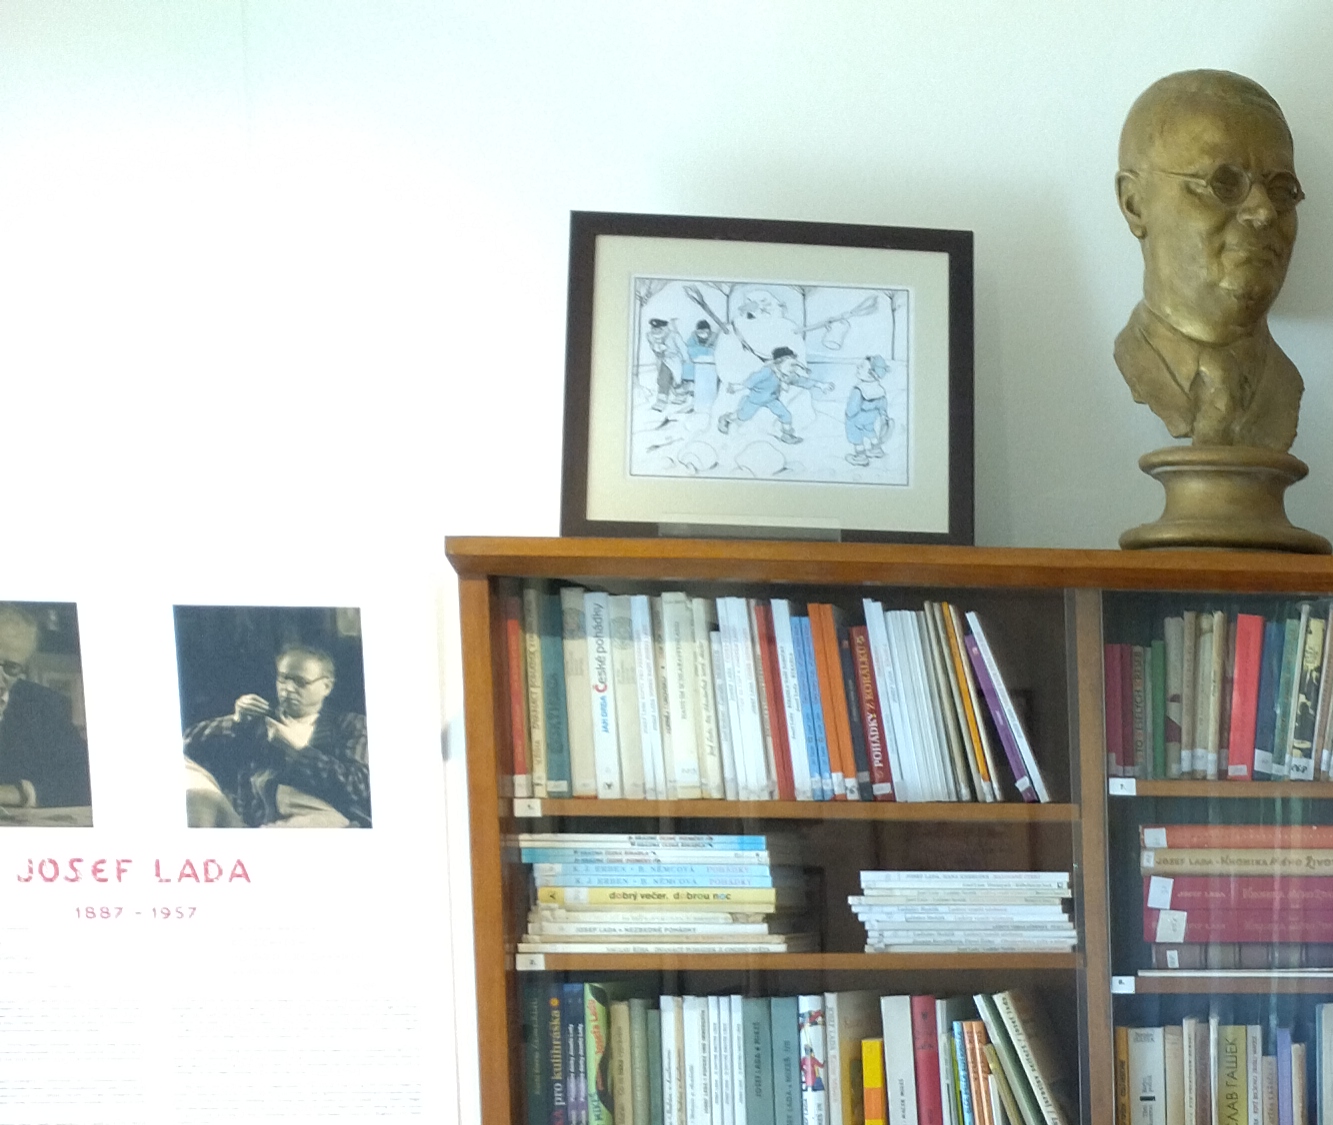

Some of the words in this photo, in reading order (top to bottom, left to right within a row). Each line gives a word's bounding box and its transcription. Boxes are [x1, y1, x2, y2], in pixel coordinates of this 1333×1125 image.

[592, 602, 608, 654] pohádky
[592, 654, 608, 693] České
[867, 712, 884, 768] POHÁDKY
[16, 858, 133, 883] JOSEF
[154, 858, 252, 883] LADA
[75, 906, 124, 919] 1887
[152, 906, 197, 919] 1957
[609, 892, 638, 901] dobrý
[673, 892, 710, 900] dobrou
[549, 1010, 563, 1080] kulihráška
[1225, 1037, 1238, 1086] ГАШЕК
[554, 1083, 566, 1106] pro
